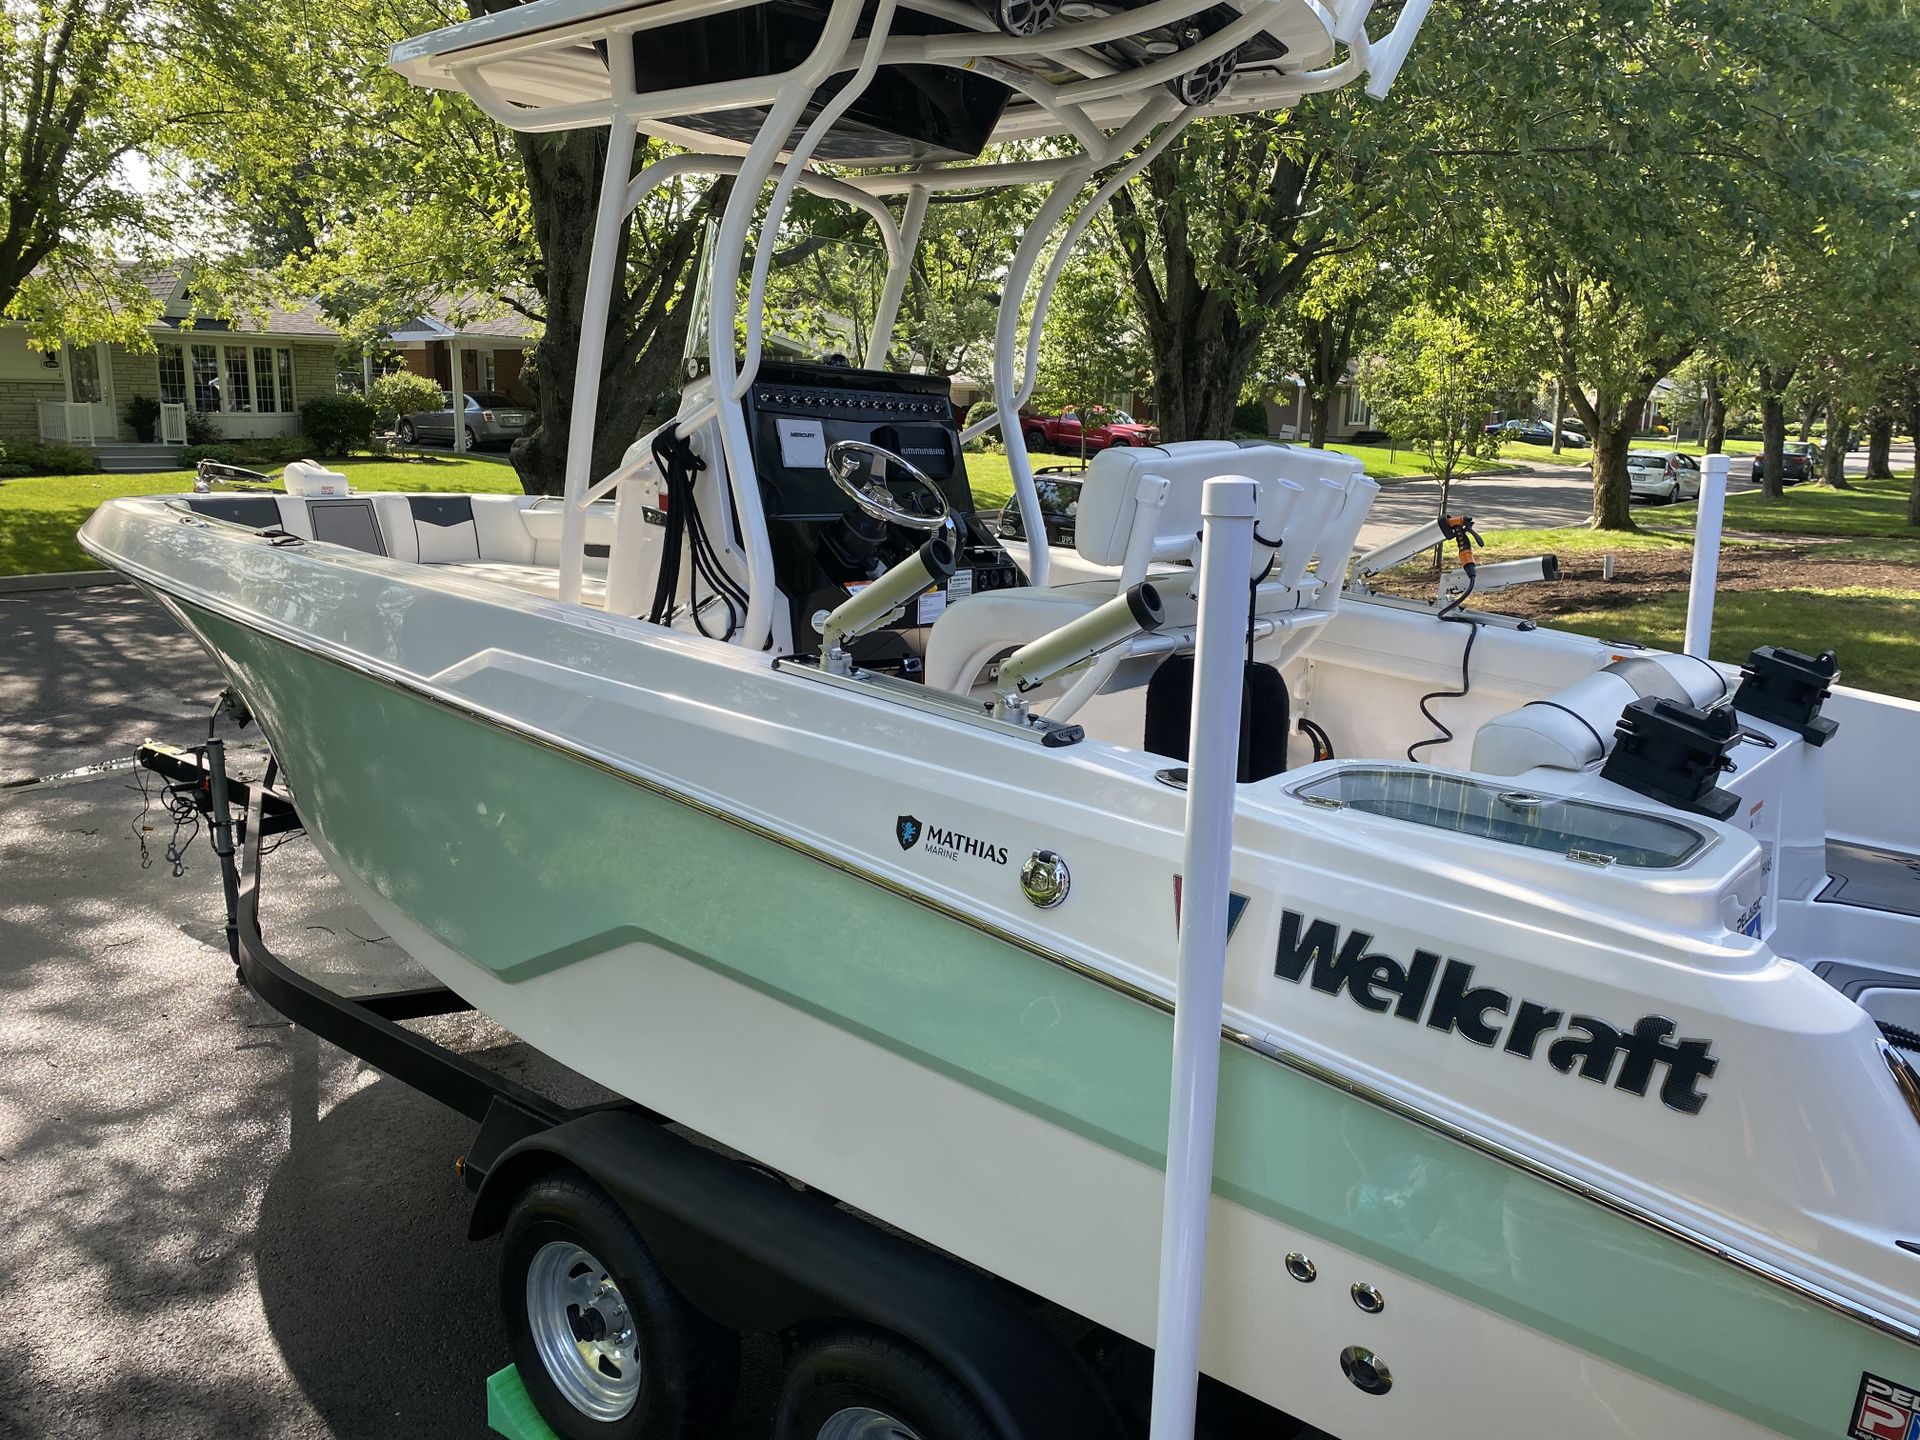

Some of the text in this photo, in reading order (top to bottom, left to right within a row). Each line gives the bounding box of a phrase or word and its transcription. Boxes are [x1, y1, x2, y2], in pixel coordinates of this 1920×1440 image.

[925, 843, 959, 862] MARINE
[927, 825, 1009, 865] MATHIAS
[1274, 907, 1719, 1115] Wellcraft
